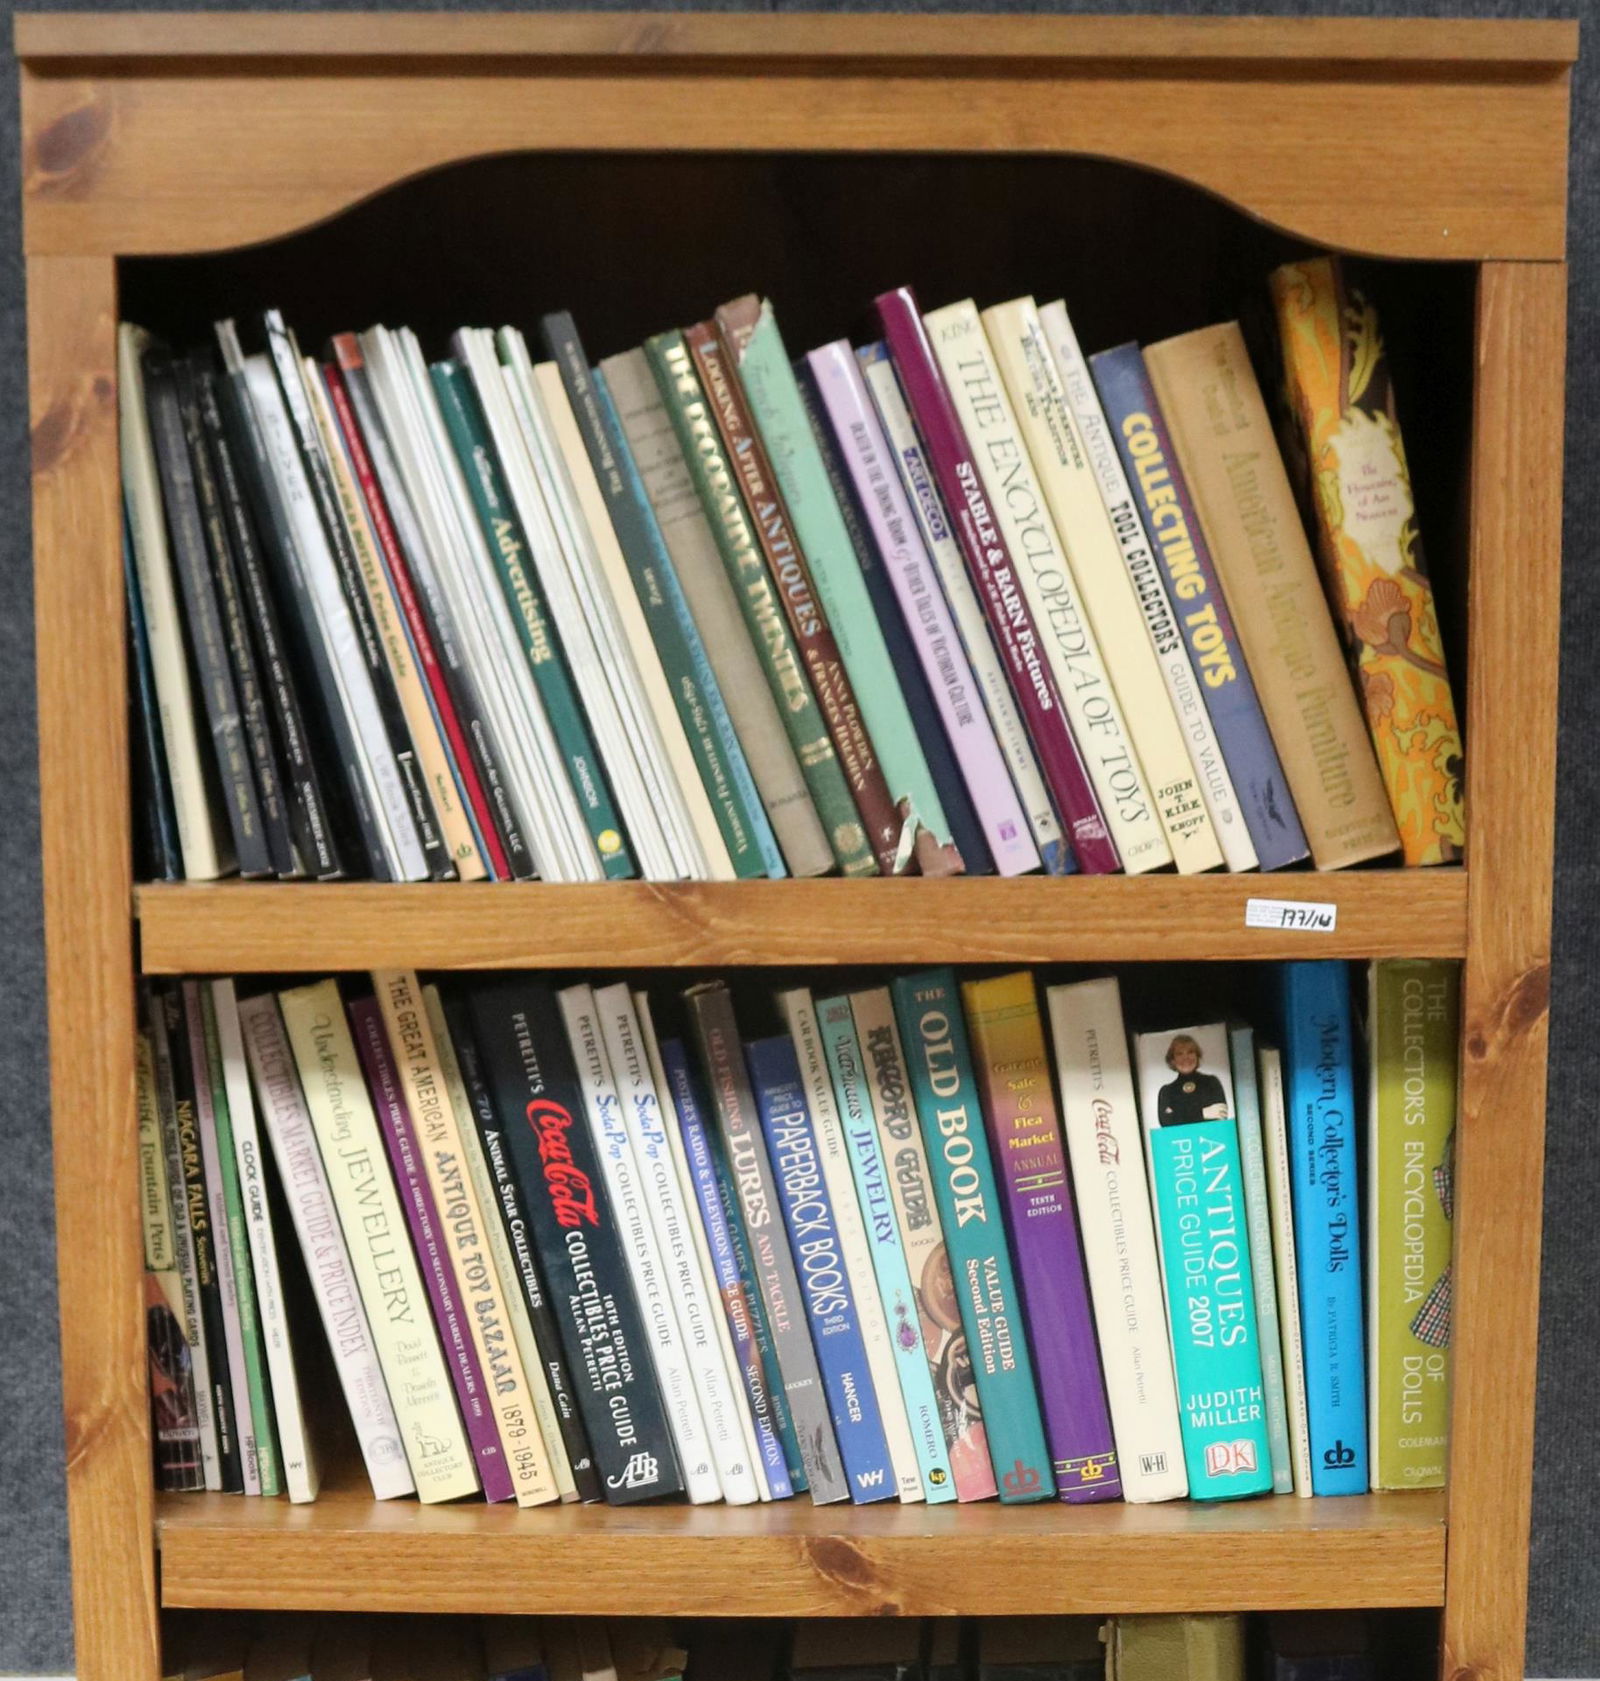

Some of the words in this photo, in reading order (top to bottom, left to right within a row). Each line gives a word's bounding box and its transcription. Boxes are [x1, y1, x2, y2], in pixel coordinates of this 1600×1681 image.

[956, 461, 998, 548] STABLE
[490, 516, 554, 664] Advertising
[754, 500, 822, 638] ANTIQUES
[957, 351, 1006, 428] THE
[986, 437, 1105, 696] ENCYCLOPEDIA
[1084, 697, 1118, 739] OF
[1101, 741, 1149, 822] TOYS
[986, 550, 1002, 565] &
[1109, 502, 1133, 540] TOOL
[1125, 544, 1181, 656] COLLECTOR'S
[1121, 412, 1198, 600] COLLECTING
[1184, 606, 1236, 690] TOYS
[993, 565, 1028, 628] BARN
[1015, 628, 1053, 711] Fixtures
[572, 754, 599, 808] JOHNSON
[1157, 780, 1194, 797] JOHN
[1164, 800, 1200, 816] KIRK
[387, 975, 404, 1003] THE
[394, 1005, 422, 1061] GREAT
[921, 1011, 959, 1097] OLD
[414, 1063, 448, 1140] AMERICAN
[242, 1140, 255, 1181] CLOCK
[435, 1151, 477, 1250] ANTIQUE
[729, 1131, 771, 1228] LURES
[758, 1233, 775, 1267] AND
[851, 1128, 896, 1247] JEWELRY
[895, 1149, 934, 1232] GUIDE
[937, 1106, 986, 1226] BOOK
[1171, 1138, 1197, 1208] PRICE
[248, 1183, 263, 1222] GUIDE
[347, 1147, 414, 1325] JEWELLERY
[771, 1111, 817, 1239] PAPERBACK
[801, 1239, 848, 1317] BOOKS
[1199, 1136, 1246, 1347] ANTIQUES
[1326, 1212, 1348, 1274] Dolls
[1404, 1142, 1423, 1303] ENCYCLOPEDIA
[463, 1254, 487, 1295] TOY
[1180, 1212, 1207, 1288] GUIDE
[474, 1297, 517, 1396] BAZAAR
[565, 1231, 609, 1342] COLLECTIBLES
[596, 1342, 622, 1391] PRICE
[609, 1395, 637, 1447] GUIDE
[967, 1259, 988, 1314] Second
[978, 1317, 995, 1374] Edition
[983, 1256, 1004, 1313] VALUE
[995, 1316, 1015, 1370] GUIDE
[1188, 1296, 1213, 1348] 2007
[1186, 1387, 1261, 1410] JUDITH
[1403, 1356, 1422, 1423] DOLLS
[1426, 1353, 1444, 1382] OF
[1192, 1405, 1262, 1428] MILLER
[1210, 1443, 1251, 1471] DK
